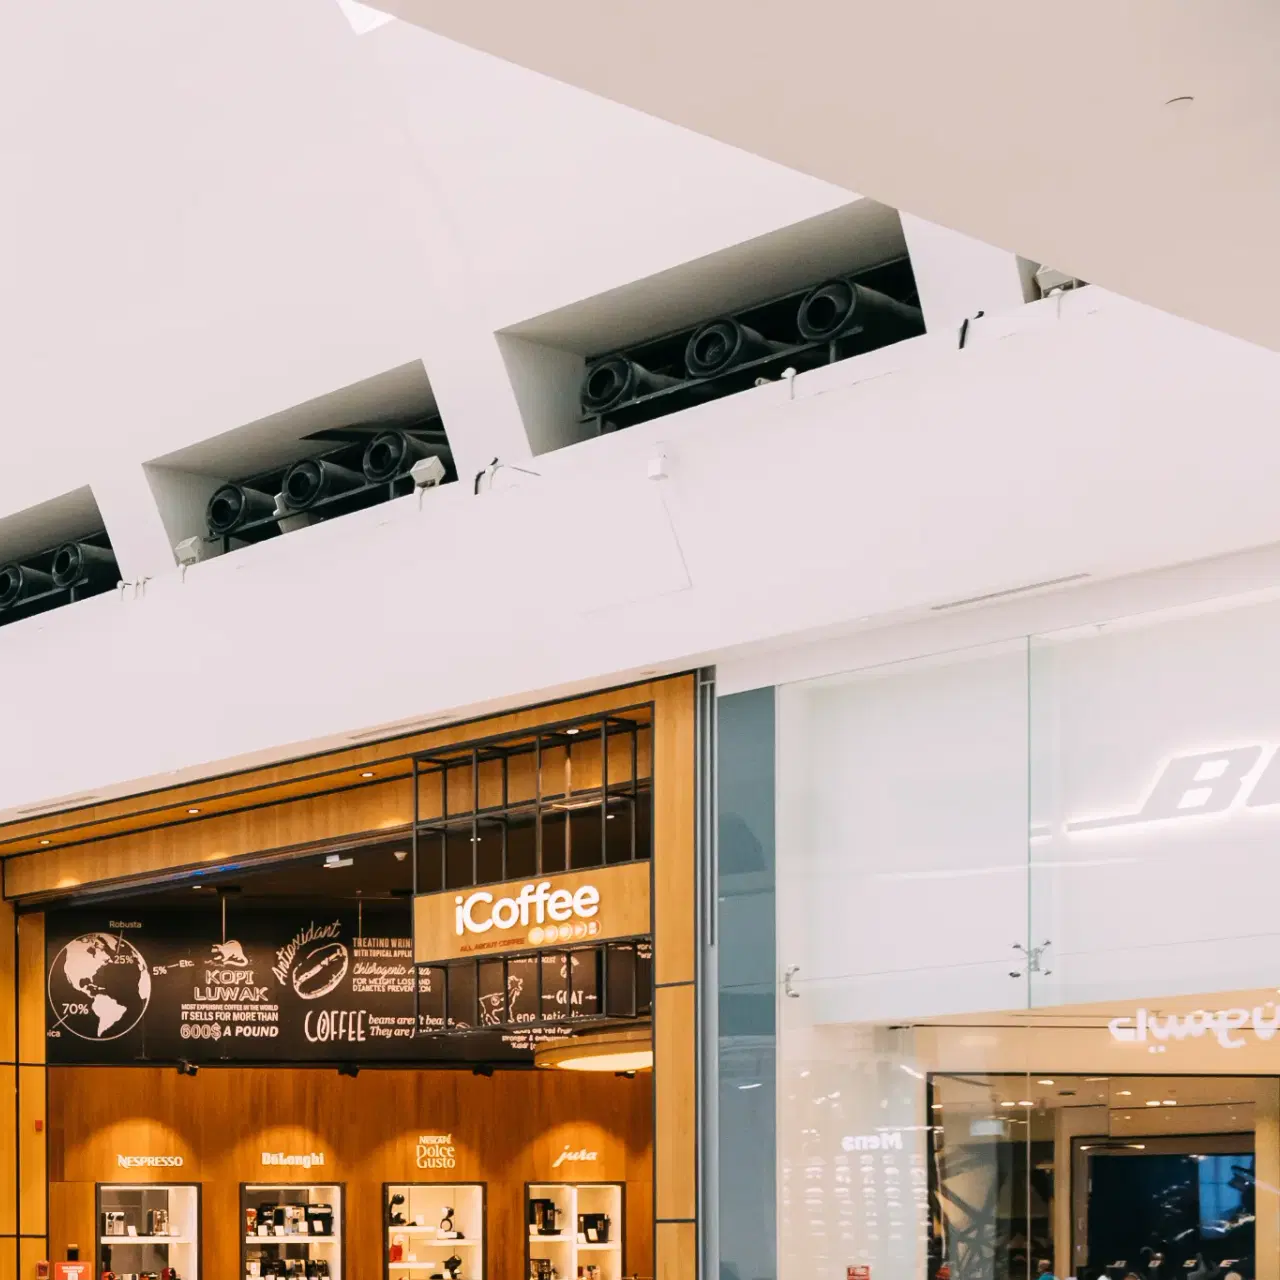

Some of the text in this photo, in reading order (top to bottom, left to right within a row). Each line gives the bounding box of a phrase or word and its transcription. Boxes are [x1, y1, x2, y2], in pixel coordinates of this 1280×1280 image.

[455, 881, 600, 936] iCoffee
[109, 920, 142, 929] Robusta
[114, 955, 134, 964] 25%
[271, 919, 341, 986] Antioxidant
[152, 966, 168, 976] 5%
[179, 960, 195, 968] Etc.
[205, 969, 254, 985] KOPI
[194, 986, 269, 1001] LUWAK
[62, 1003, 89, 1015] 70%
[181, 1011, 279, 1022] IT SELLS FOR MORE THAN
[180, 1022, 279, 1041] 600$ A POUND
[304, 1010, 367, 1042] COFFEE
[368, 1014, 396, 1025] beans
[369, 1026, 393, 1039] They
[396, 1028, 410, 1037] are
[416, 1144, 455, 1158] Dolce
[551, 1145, 599, 1168] jura
[117, 1154, 183, 1169] NESPRESSO
[416, 1157, 456, 1169] Gusto
